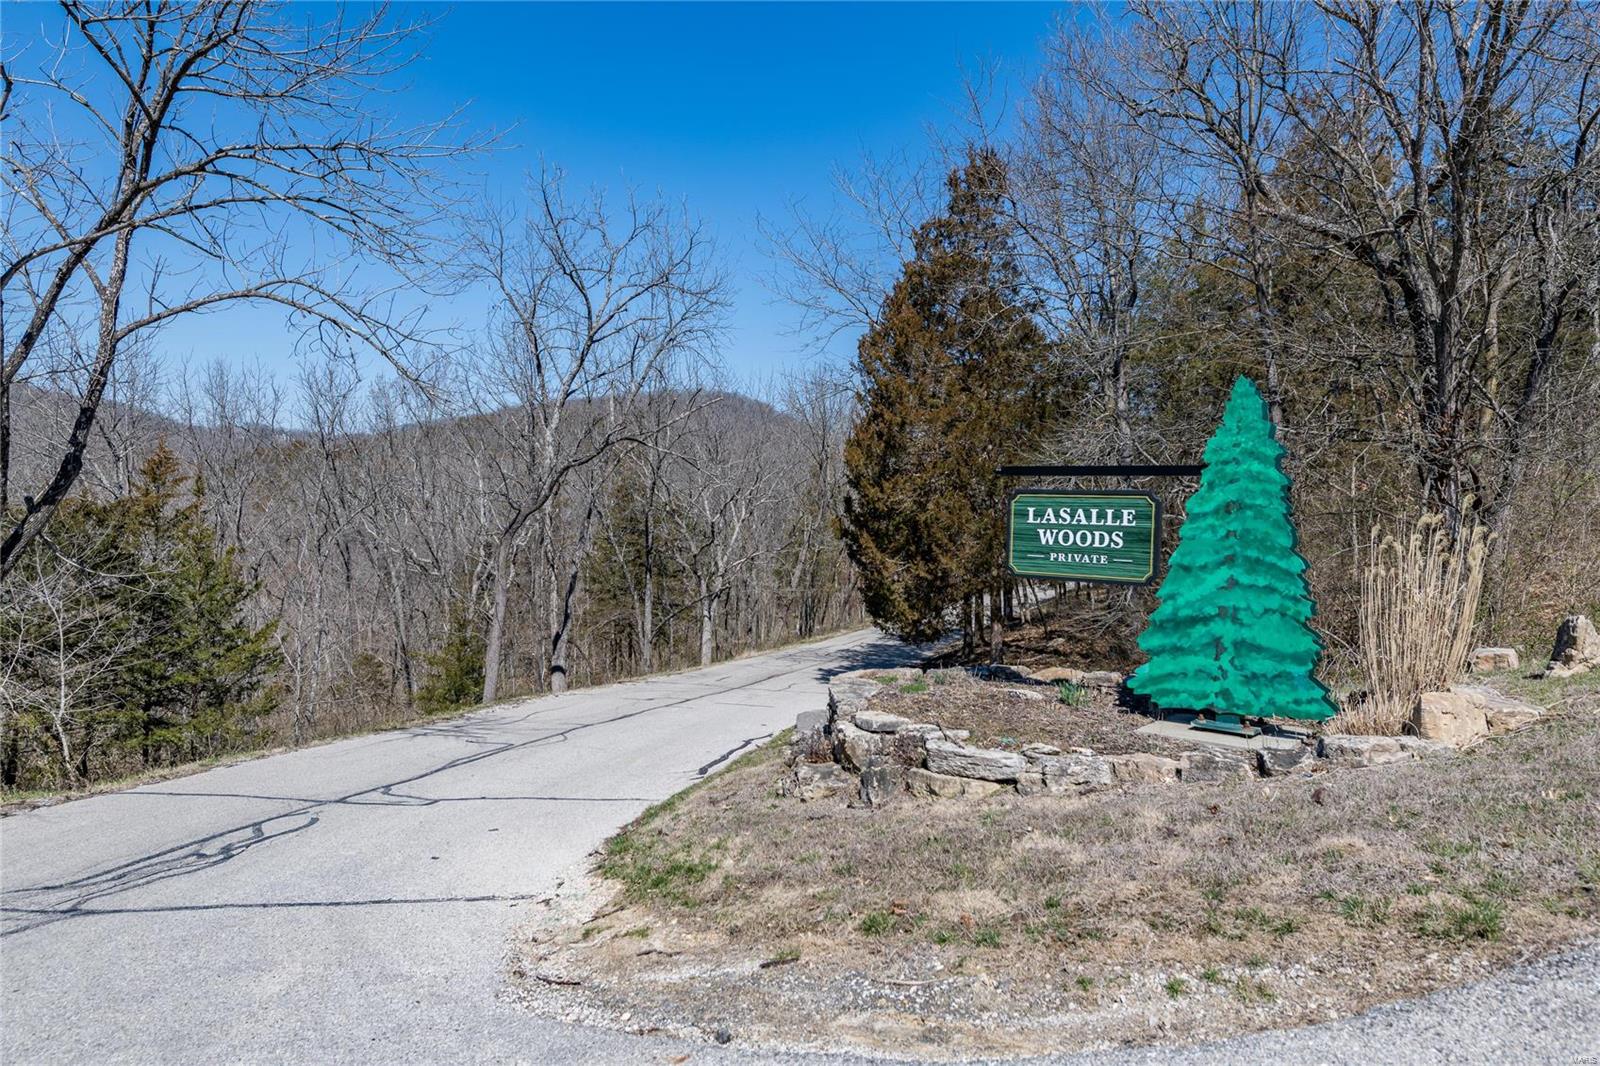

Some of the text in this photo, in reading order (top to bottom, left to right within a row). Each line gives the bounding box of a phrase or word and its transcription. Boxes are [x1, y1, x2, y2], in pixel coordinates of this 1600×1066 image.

[1026, 507, 1137, 526] LASALLE
[1037, 528, 1124, 549] WOODS
[1049, 552, 1108, 564] PRIVATE
